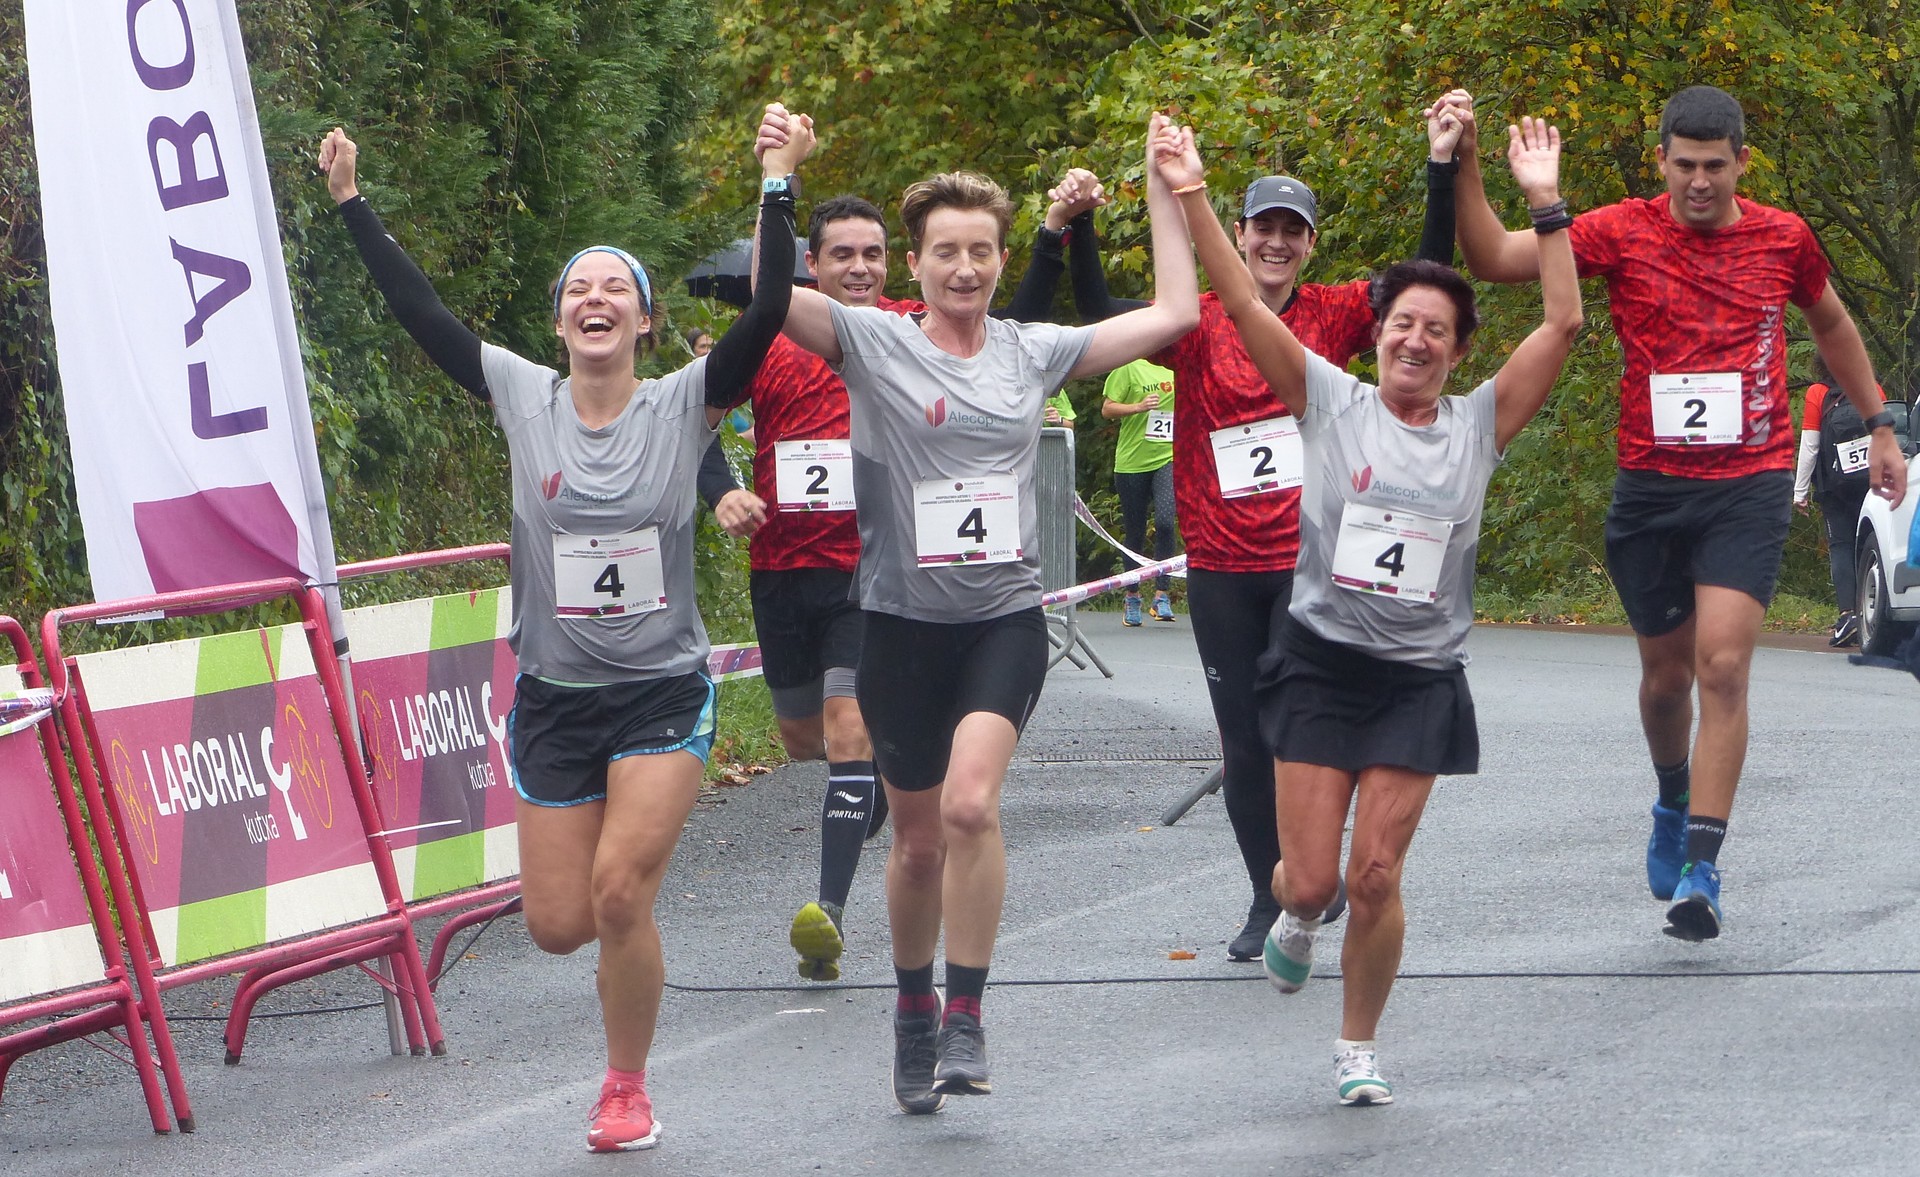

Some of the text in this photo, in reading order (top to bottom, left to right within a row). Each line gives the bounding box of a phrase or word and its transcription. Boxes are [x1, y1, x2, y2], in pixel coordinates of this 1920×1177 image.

[1153, 420, 1171, 433] 21
[1683, 398, 1708, 429] 2
[1249, 446, 1277, 478] 2
[1848, 446, 1868, 464] 57
[805, 465, 829, 495] 2
[957, 507, 987, 544] 4
[1374, 542, 1405, 578] 4
[593, 563, 625, 599] 4
[628, 598, 655, 609] LABORAL
[389, 686, 486, 761] LABORAL
[142, 732, 267, 816] LABORAL
[467, 759, 496, 790] kutxa
[243, 811, 280, 845] kutxa
[828, 811, 864, 820] SPORTLAST
